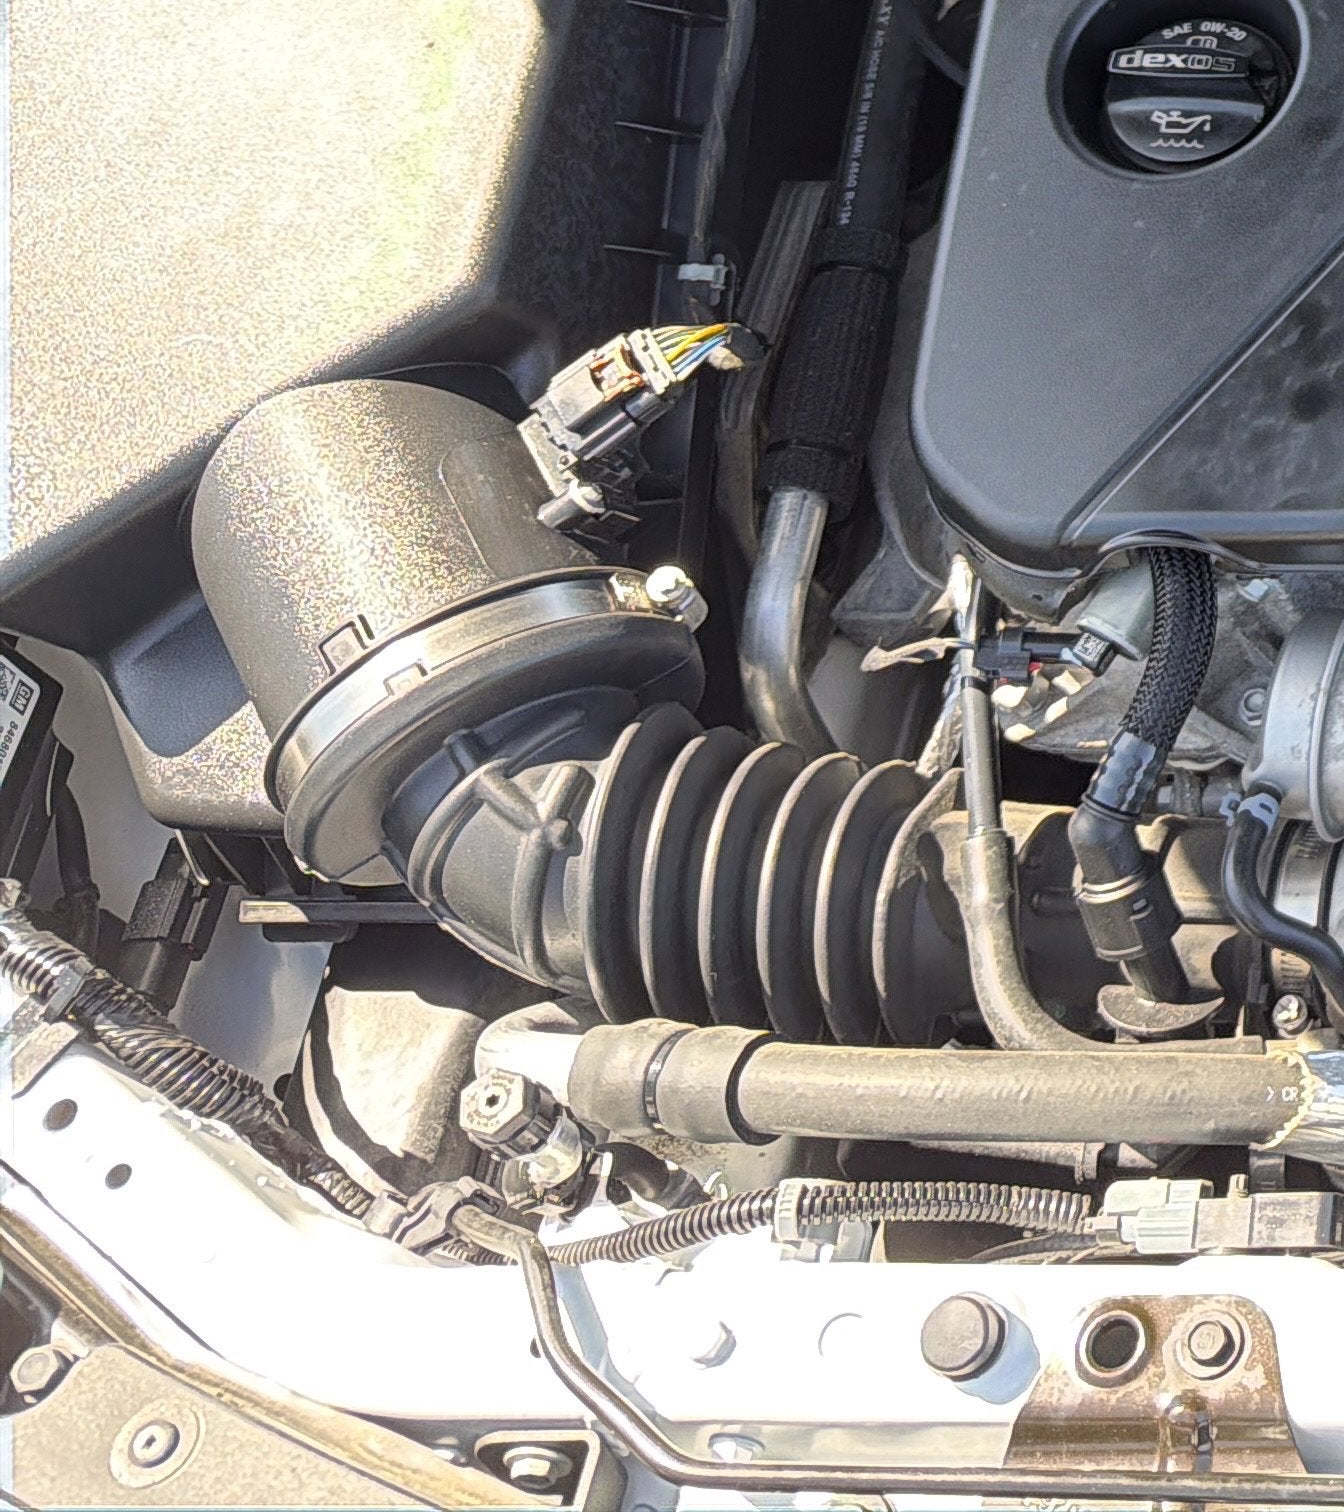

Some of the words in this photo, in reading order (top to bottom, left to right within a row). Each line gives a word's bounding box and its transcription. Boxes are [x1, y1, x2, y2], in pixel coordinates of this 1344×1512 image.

[1161, 22, 1193, 39] SAE
[1201, 21, 1247, 41] 0W-20
[1118, 49, 1236, 72] dexos
[12, 684, 32, 714] GM
